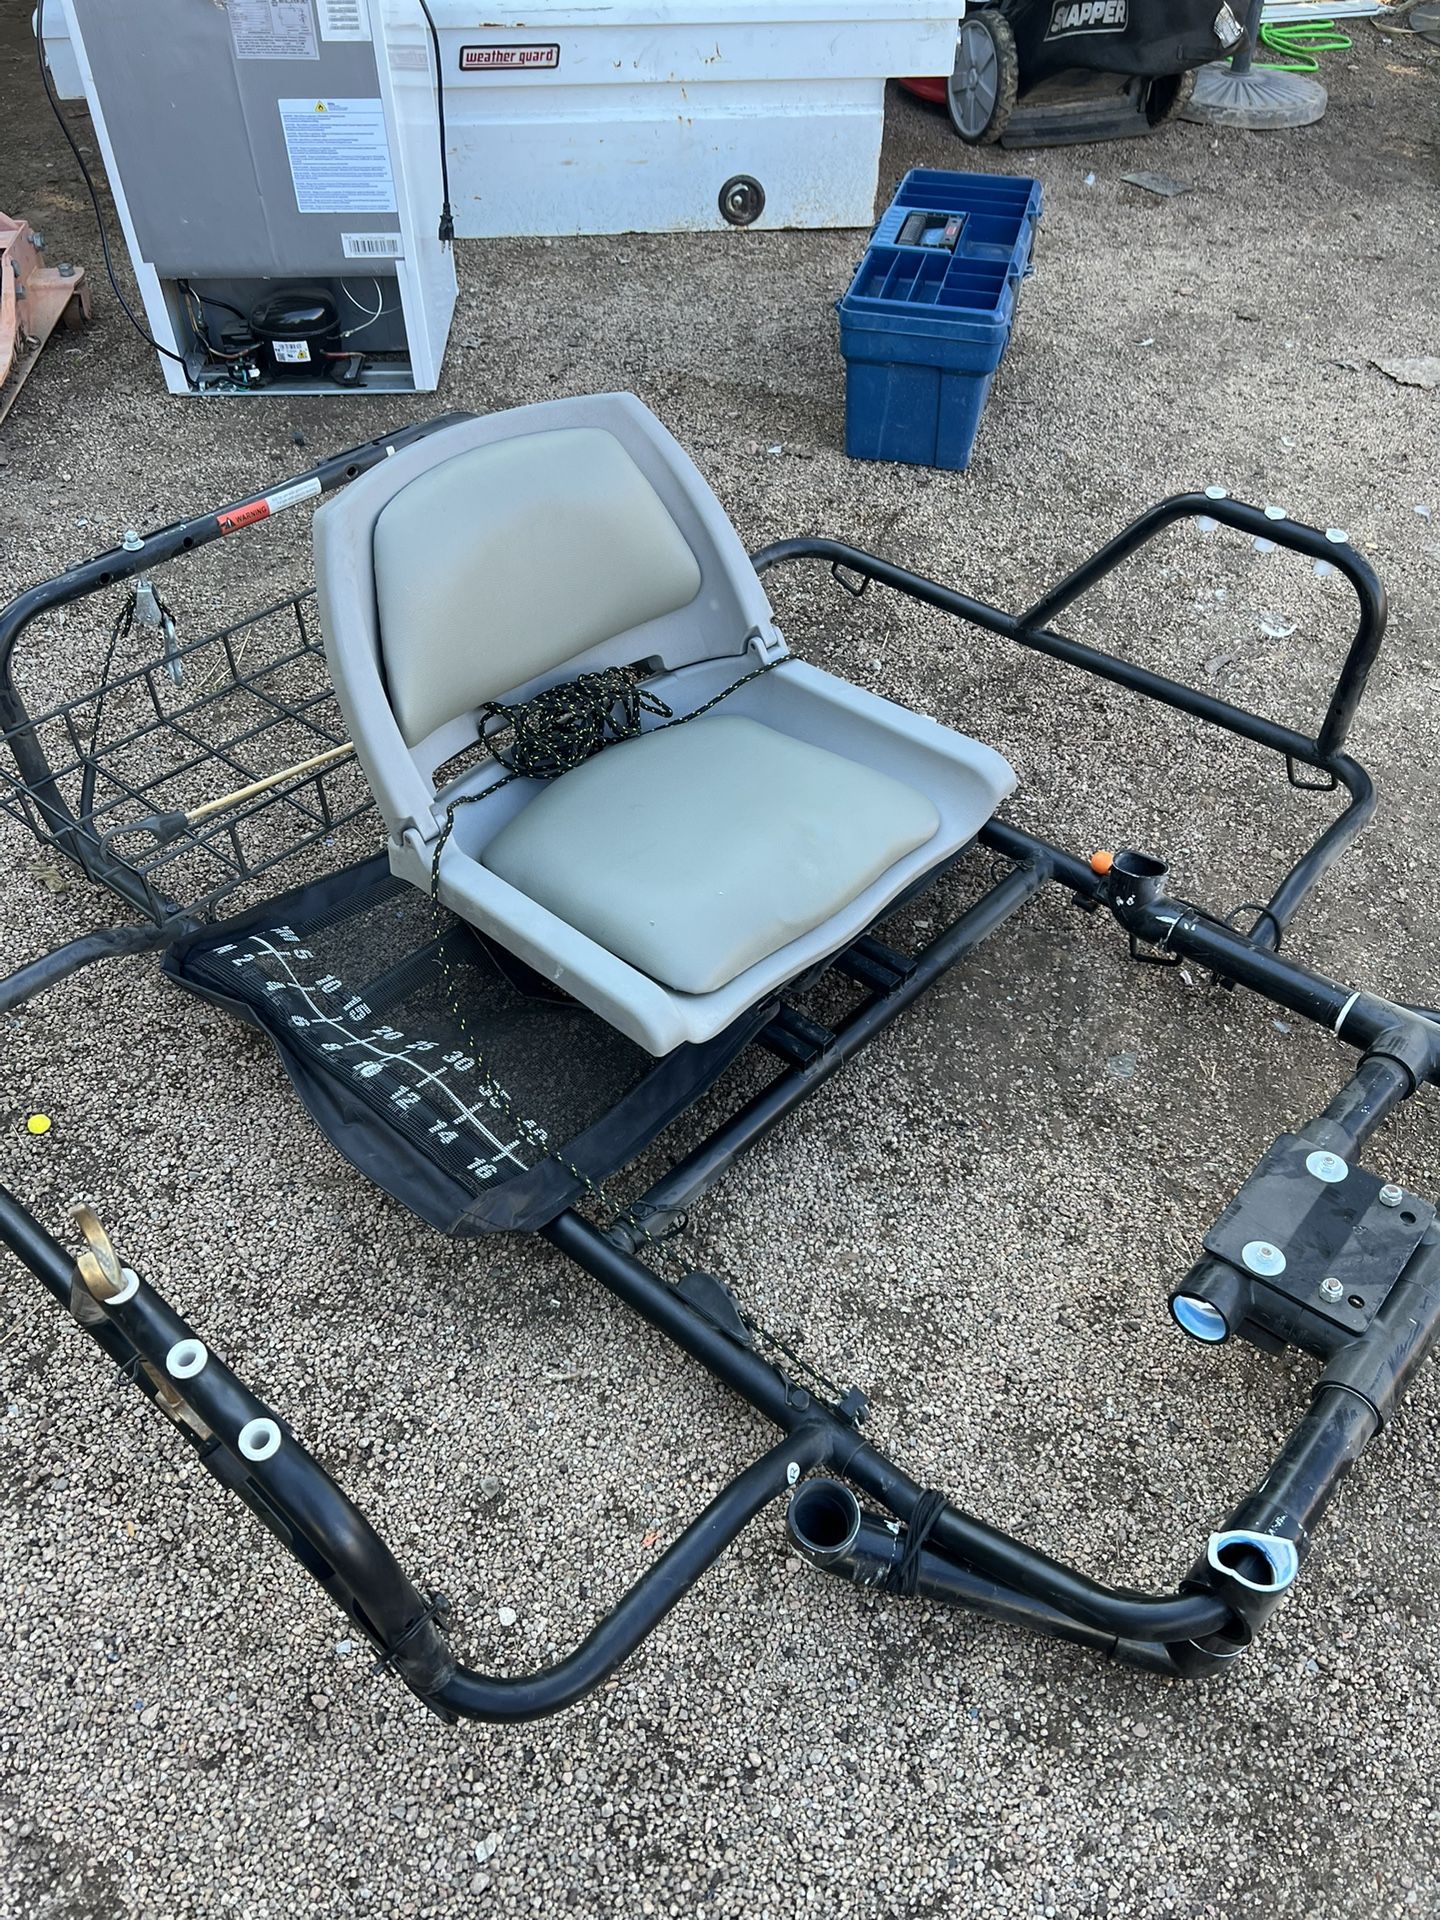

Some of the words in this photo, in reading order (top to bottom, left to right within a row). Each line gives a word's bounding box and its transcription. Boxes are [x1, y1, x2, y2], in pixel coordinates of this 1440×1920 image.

[466, 50, 517, 63] weather
[519, 49, 554, 64] guard
[235, 506, 267, 522] WARNING
[293, 949, 314, 960] 5
[315, 973, 343, 994] 10
[343, 995, 372, 1022] 15
[372, 1025, 405, 1040] 20
[405, 1040, 440, 1051] 25
[442, 1050, 475, 1072] 30
[232, 953, 255, 967] 2
[265, 980, 287, 992] 4
[291, 1015, 311, 1027] 6
[321, 1041, 344, 1051] 8
[353, 1060, 386, 1078] 10
[390, 1085, 422, 1111] 12
[428, 1119, 459, 1144] 14
[467, 1157, 498, 1179] 16
